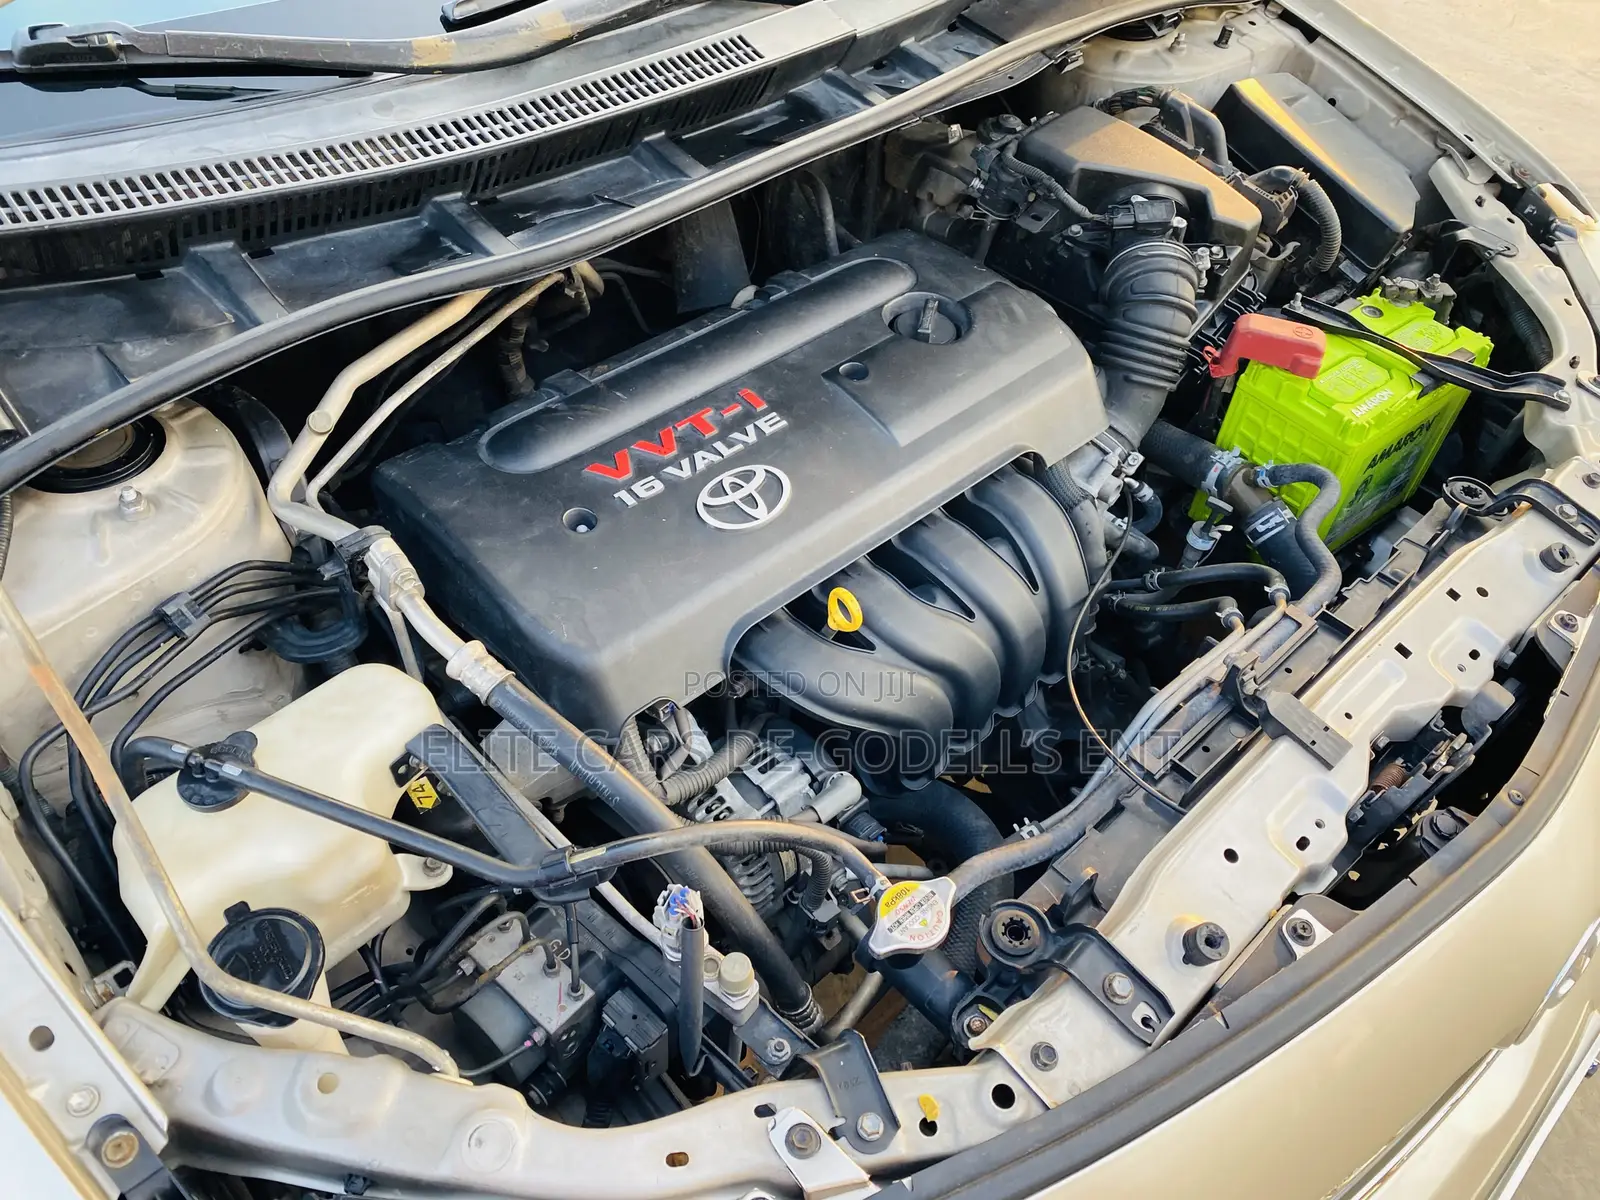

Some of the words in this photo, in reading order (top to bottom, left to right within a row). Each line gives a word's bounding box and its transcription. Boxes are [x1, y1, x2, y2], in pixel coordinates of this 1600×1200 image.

[1350, 389, 1394, 418] AMARON
[1362, 412, 1441, 475] AMARON
[612, 475, 666, 509] 16
[661, 411, 789, 480] VALVE
[884, 886, 911, 909] 108kPa
[908, 911, 943, 941] CAUTION
